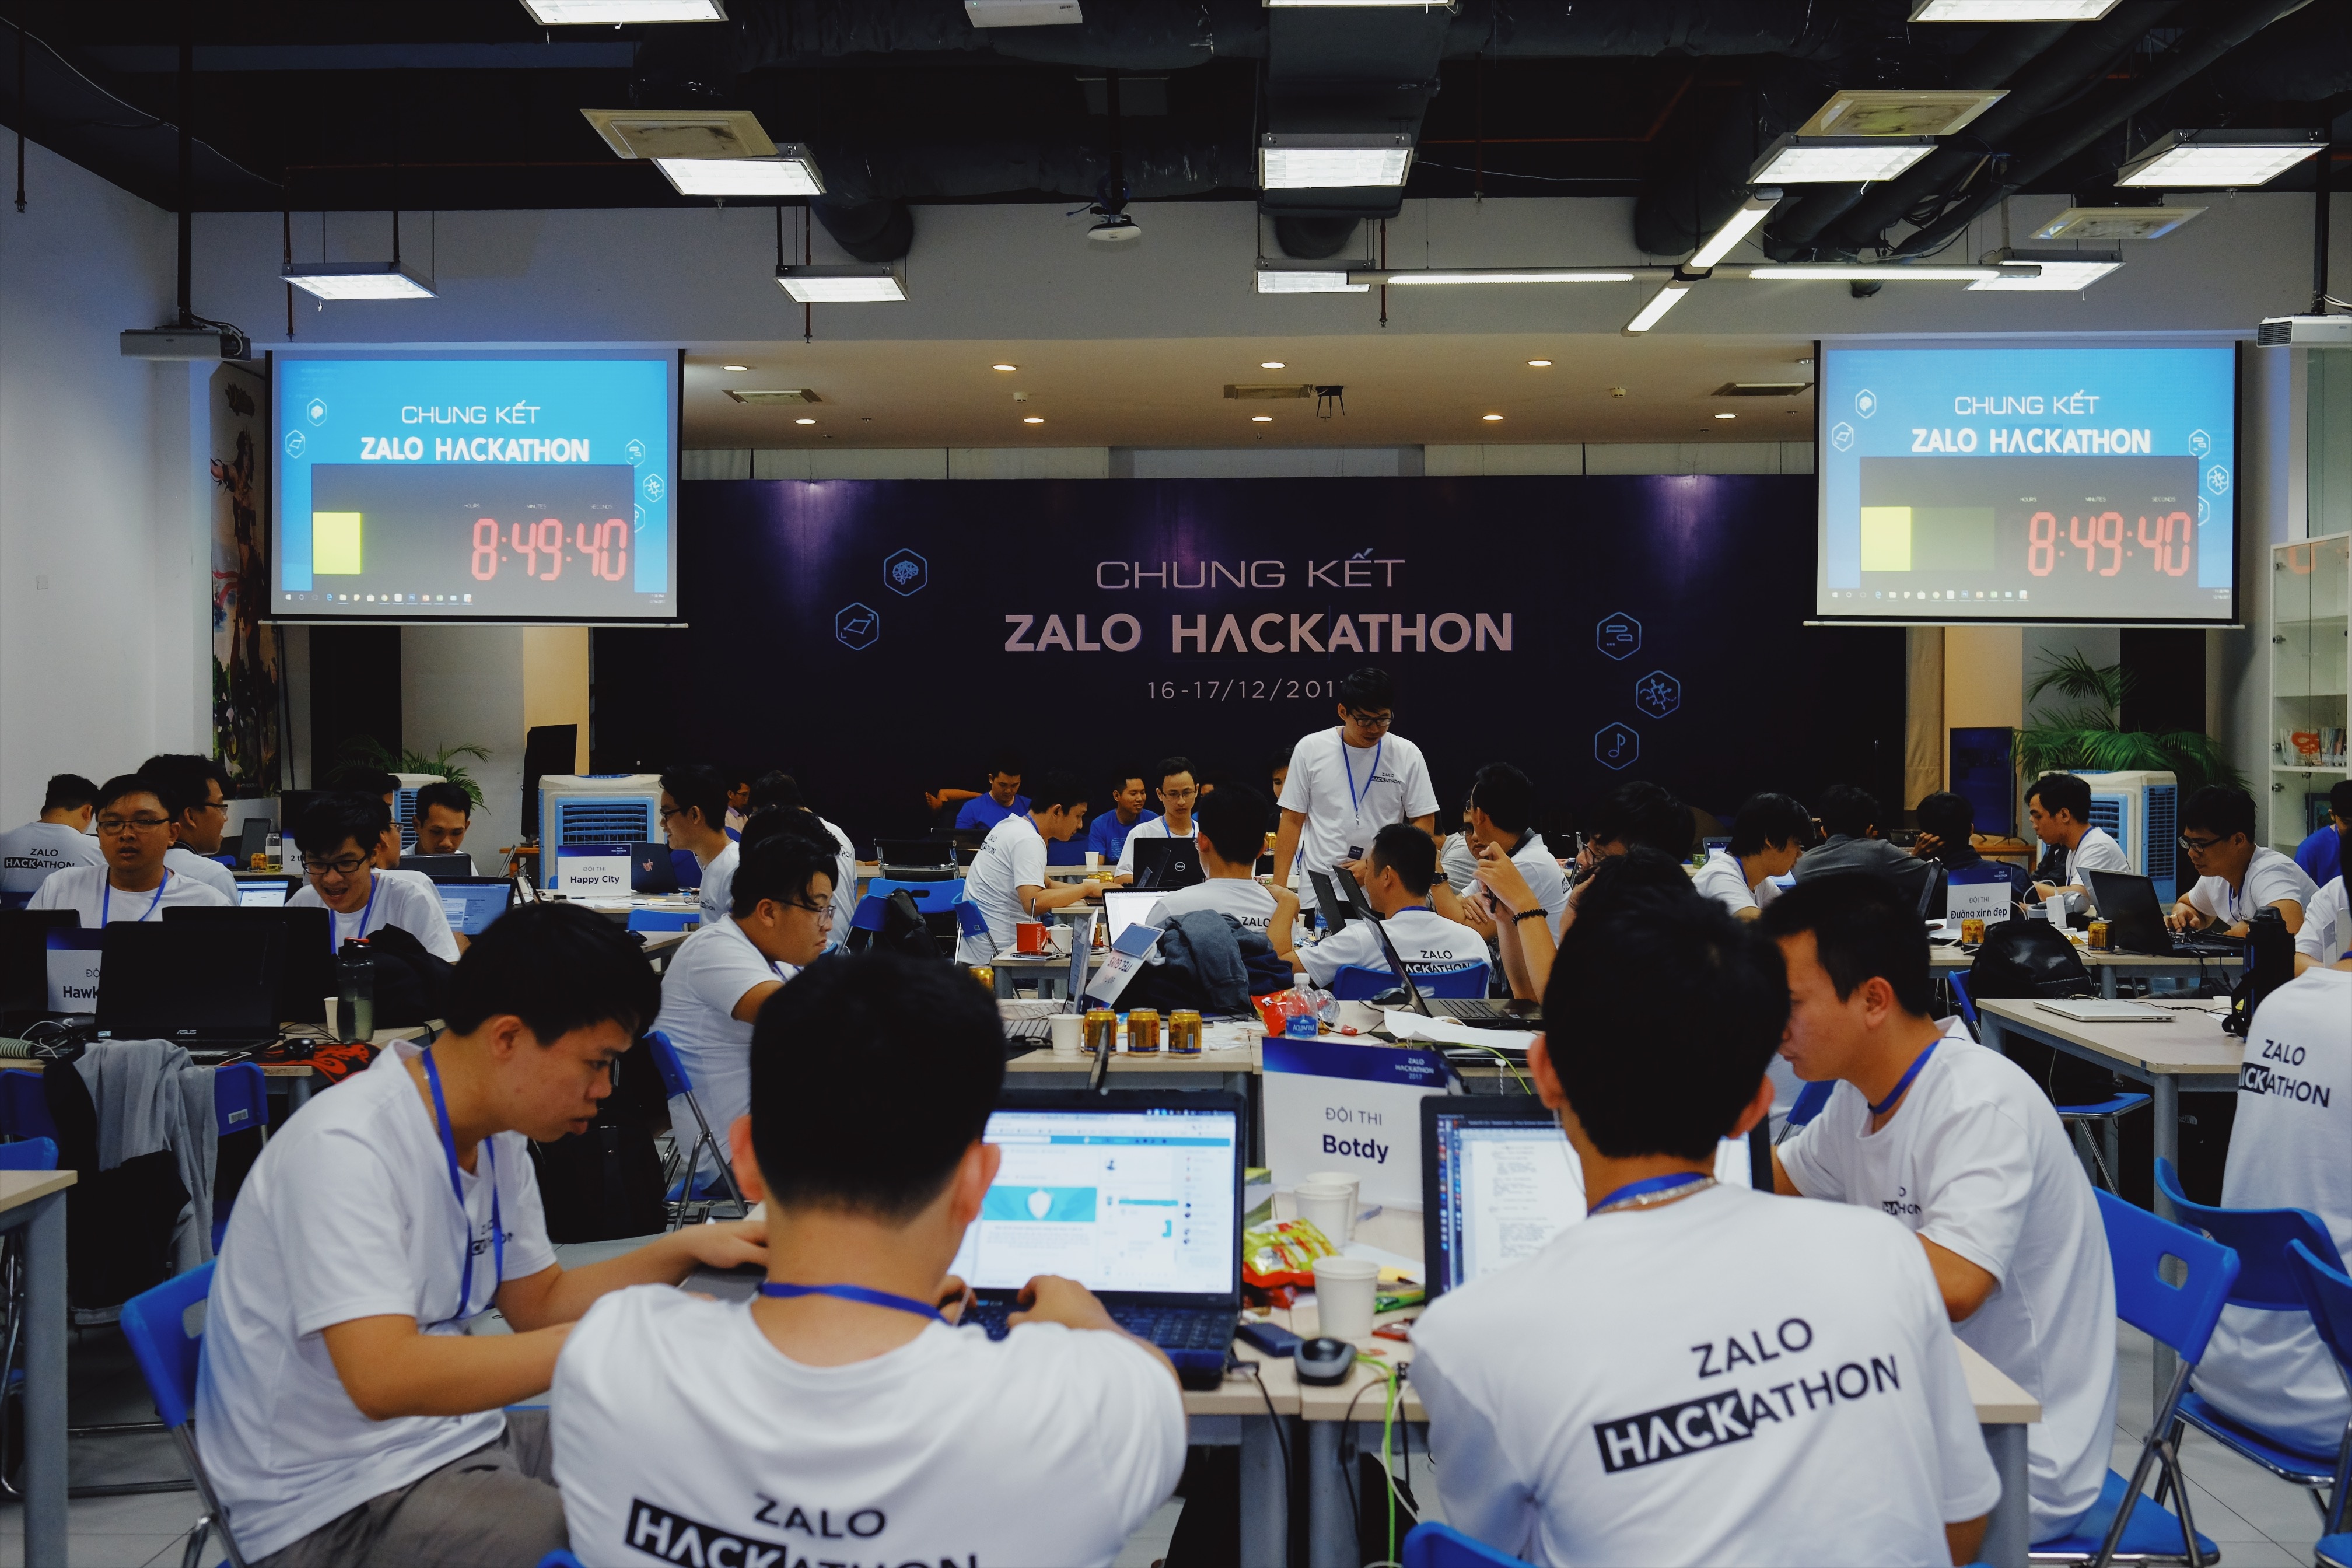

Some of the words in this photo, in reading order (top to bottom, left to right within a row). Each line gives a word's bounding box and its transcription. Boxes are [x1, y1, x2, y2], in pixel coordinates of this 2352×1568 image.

[401, 406, 487, 424] CHUNG
[496, 400, 541, 424] KẾT
[1955, 396, 2043, 415] CHUNG
[2053, 388, 2099, 415] KẾT
[360, 436, 424, 460] ZALO
[435, 437, 589, 462] HACKATHON
[1912, 428, 1978, 453] ZALO
[1990, 428, 2151, 454] HACKATHON
[471, 518, 628, 581] 8:49:40
[2028, 512, 2192, 576] 8:49:40
[1096, 560, 1285, 589] CHUNG
[1308, 548, 1406, 587] KẾT
[1005, 612, 1142, 652] ZALO
[1172, 612, 1514, 653] HACKATHON
[1147, 678, 1343, 701] 16-17/12/201
[30, 848, 58, 857] ZALO
[570, 876, 599, 884] Happy
[602, 876, 620, 884] City
[1241, 916, 1270, 928] ZALO
[1993, 907, 2007, 918] đẹp
[1420, 950, 1452, 960] ZALO
[86, 968, 100, 979] ĐỘ
[2262, 1039, 2306, 1066] ZALO
[1325, 1106, 1352, 1124] ĐỘI
[1358, 1110, 1382, 1126] THI
[1322, 1133, 1389, 1164] Botdy
[1690, 1317, 1814, 1380] ZALO
[1597, 1354, 1901, 1472] HACKATHON
[754, 1492, 887, 1538] ZALO
